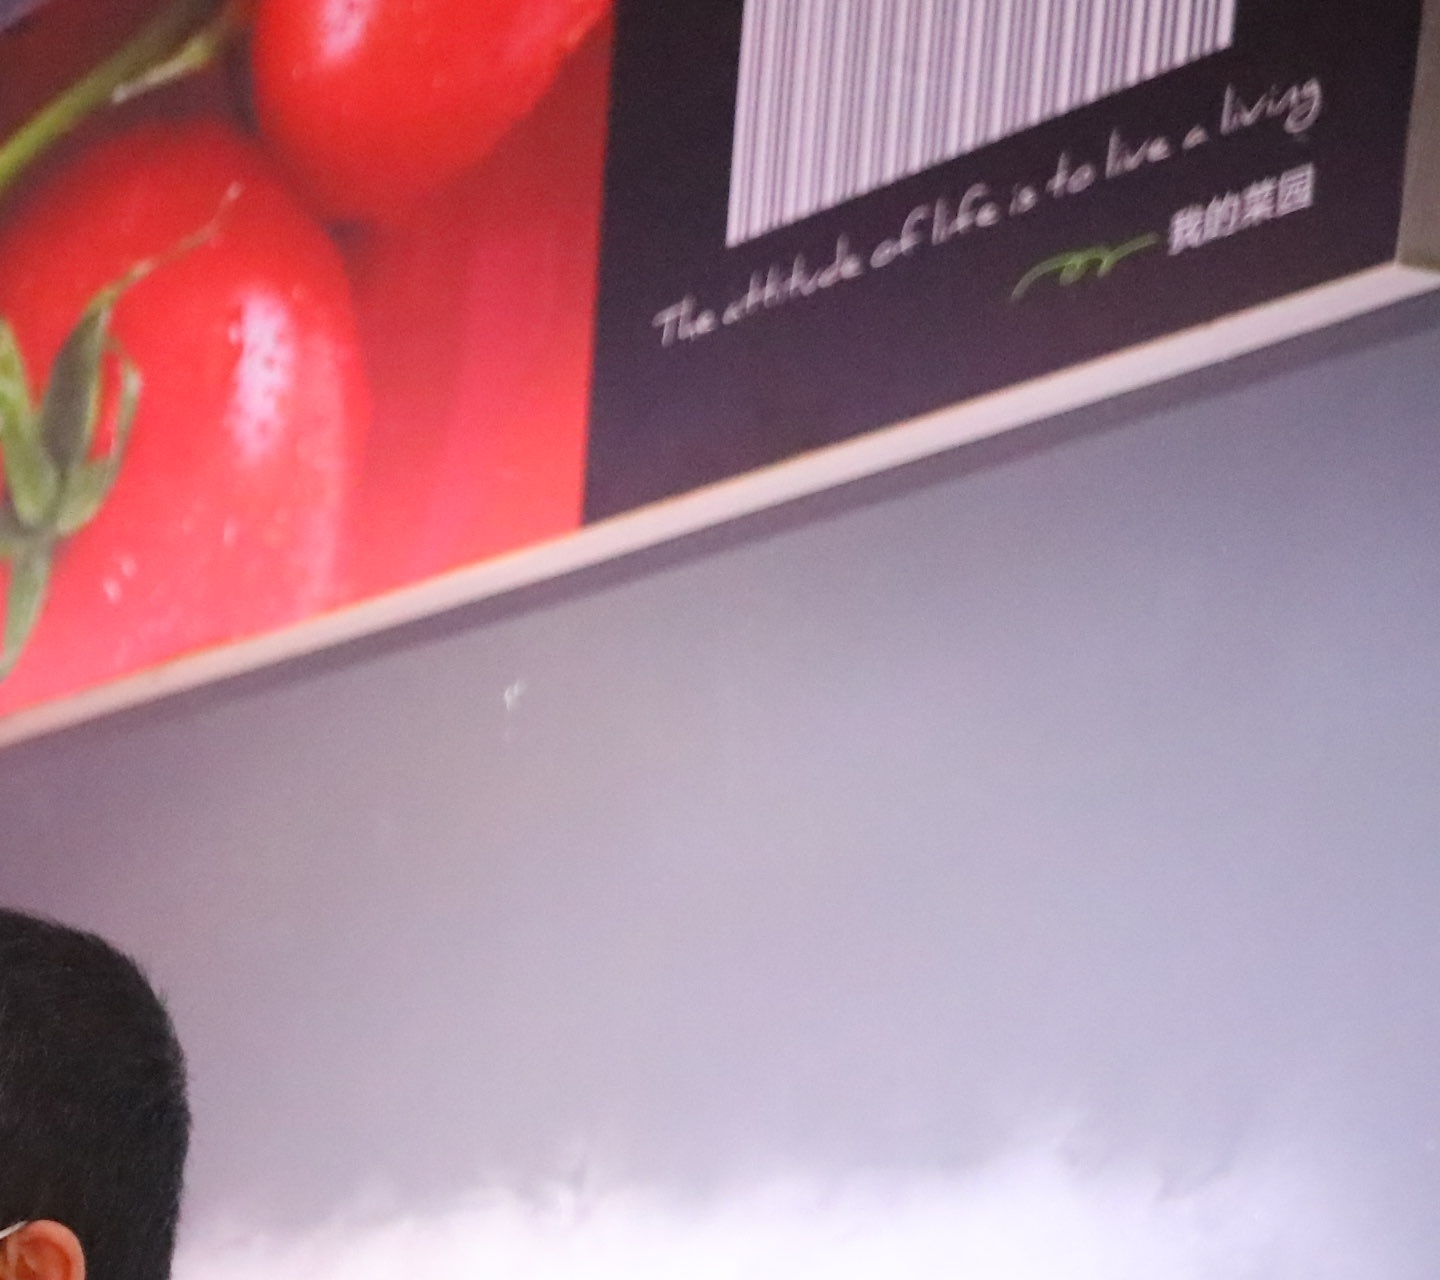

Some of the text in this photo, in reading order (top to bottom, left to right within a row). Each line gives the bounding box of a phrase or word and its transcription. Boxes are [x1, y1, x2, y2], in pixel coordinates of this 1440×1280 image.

[652, 293, 717, 347] The
[723, 234, 862, 322] attitude
[870, 202, 930, 268] of
[932, 182, 1000, 246] life
[1046, 152, 1096, 198] to
[1106, 128, 1171, 179] live
[1182, 123, 1209, 150] a
[1221, 77, 1321, 135] living
